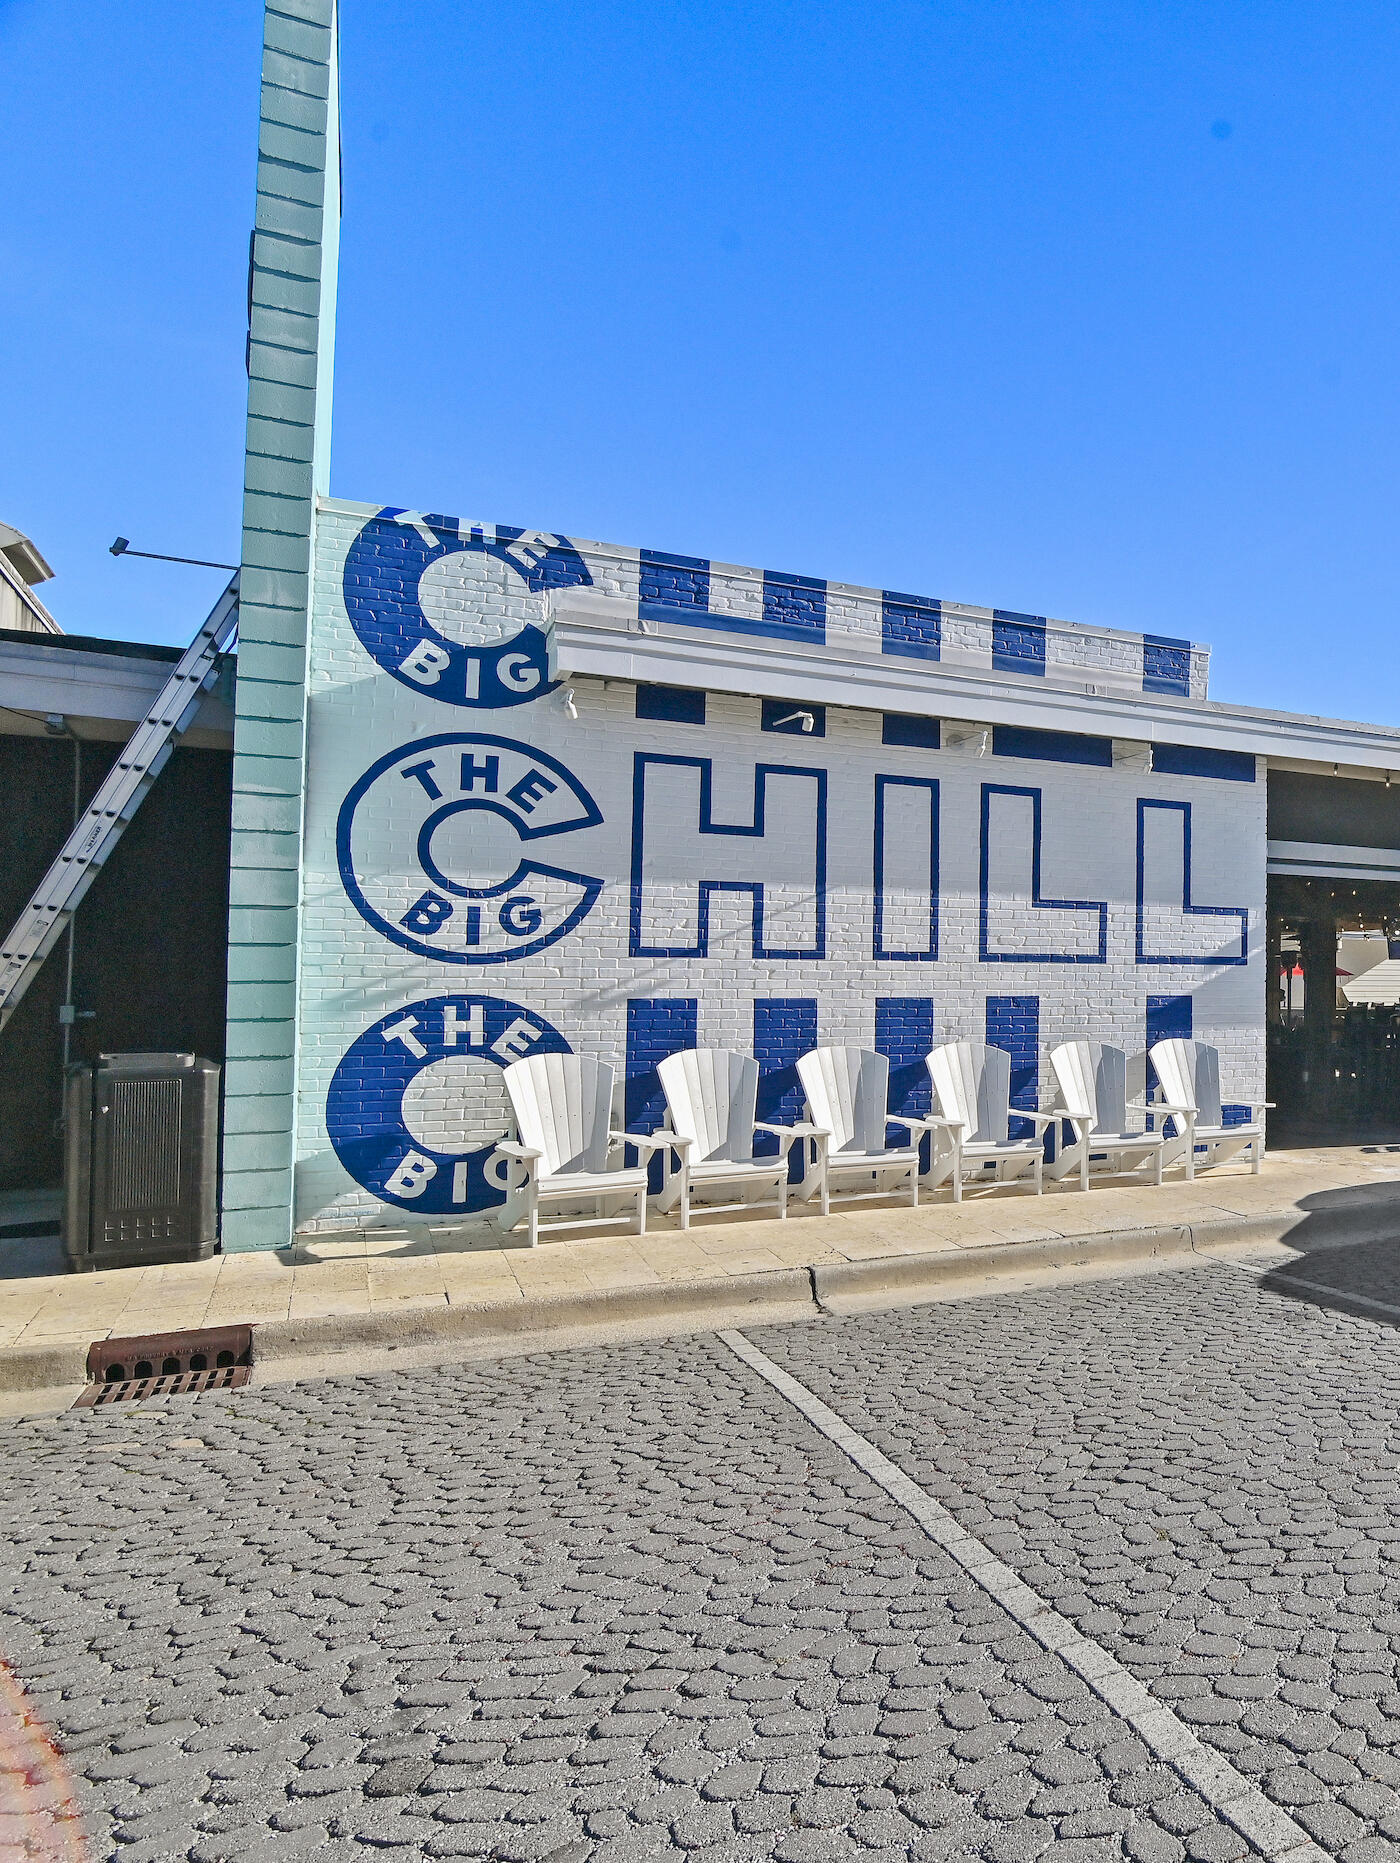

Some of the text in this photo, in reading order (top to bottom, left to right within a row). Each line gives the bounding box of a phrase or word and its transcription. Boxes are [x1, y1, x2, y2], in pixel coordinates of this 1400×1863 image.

[393, 510, 560, 569] THE
[398, 638, 541, 699] BIG
[401, 753, 558, 814] THE
[399, 890, 543, 945] BIG
[381, 1005, 543, 1064] THE
[384, 1149, 530, 1204] BIG
